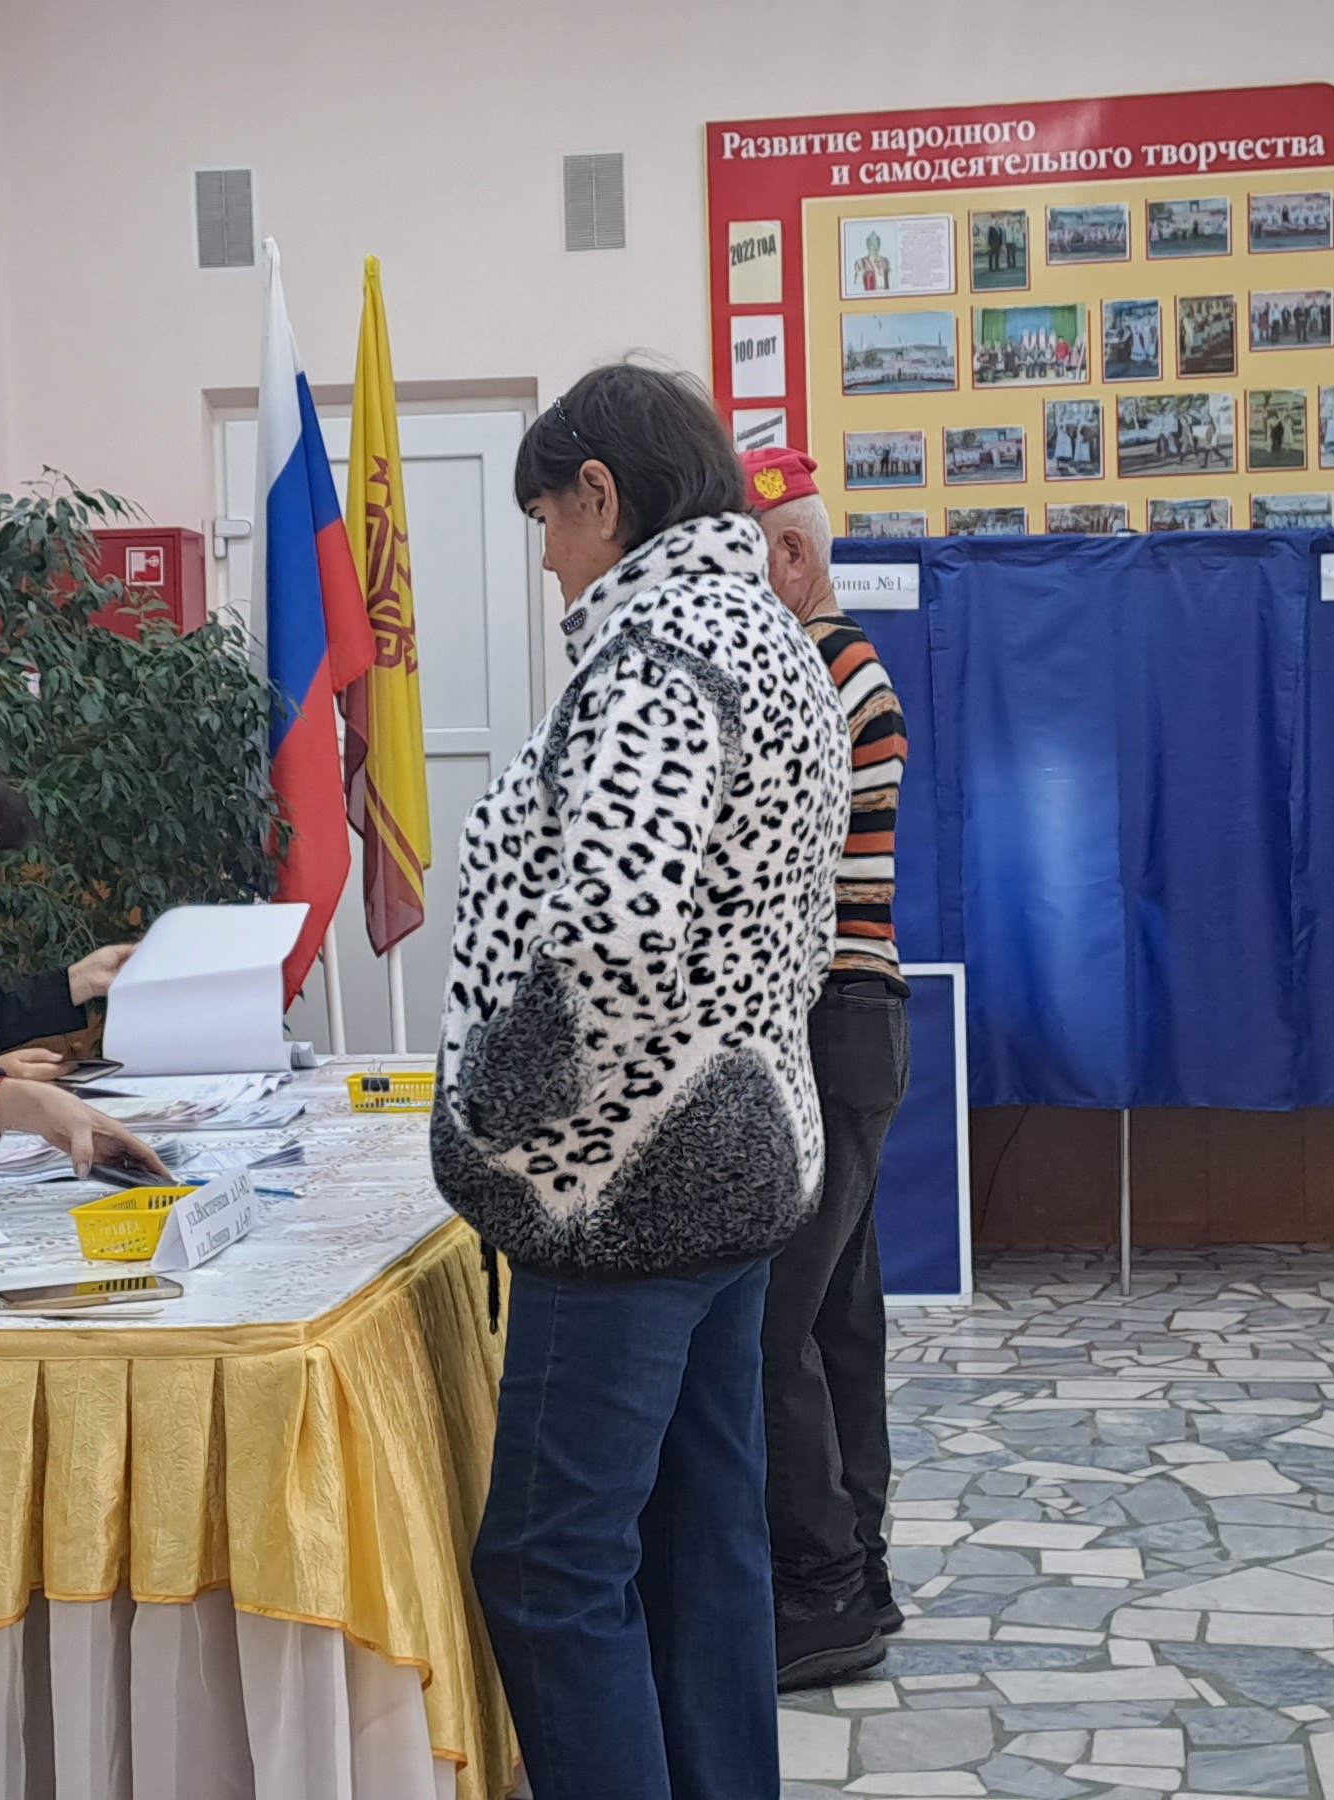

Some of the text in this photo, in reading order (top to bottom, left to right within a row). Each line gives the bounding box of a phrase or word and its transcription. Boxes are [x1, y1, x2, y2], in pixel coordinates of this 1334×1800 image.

[721, 120, 1036, 160] Развитие народного
[830, 133, 1325, 186] и самодеятельного творчества
[730, 237, 755, 267] 2022
[734, 338, 753, 363] 100
[832, 576, 901, 591] бина №1
